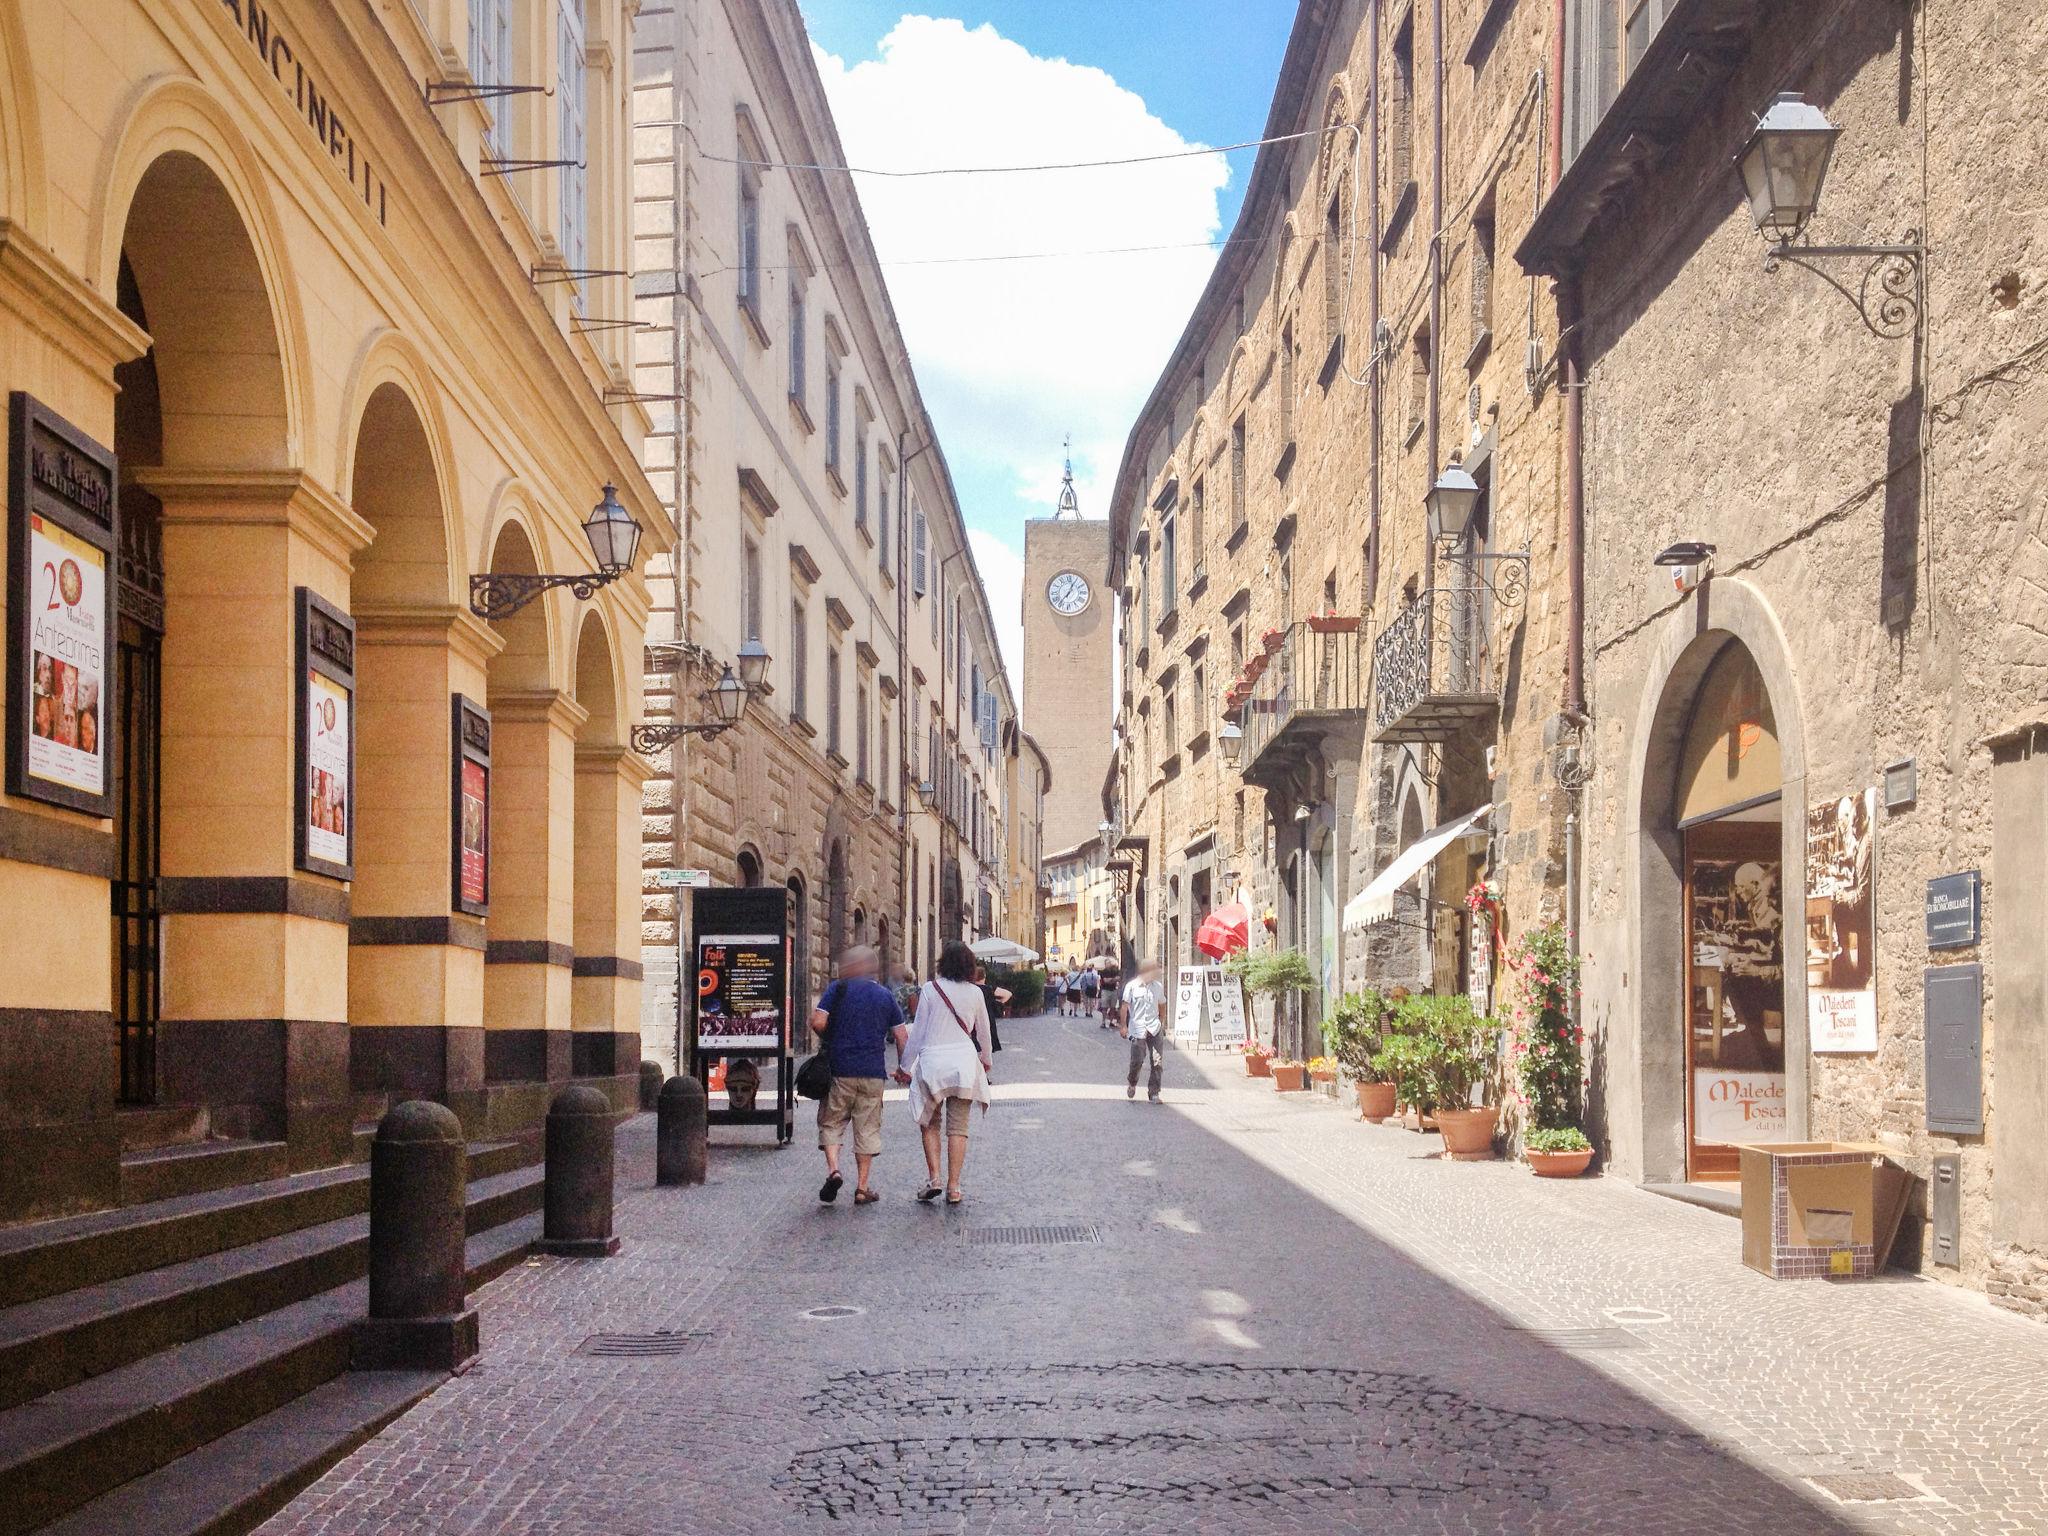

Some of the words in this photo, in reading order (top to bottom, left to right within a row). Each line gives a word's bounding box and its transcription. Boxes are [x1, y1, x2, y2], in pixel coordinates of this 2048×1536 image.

[43, 559, 82, 610] 20
[316, 698, 336, 736] 20
[1214, 1033, 1244, 1041] CONVERSE
